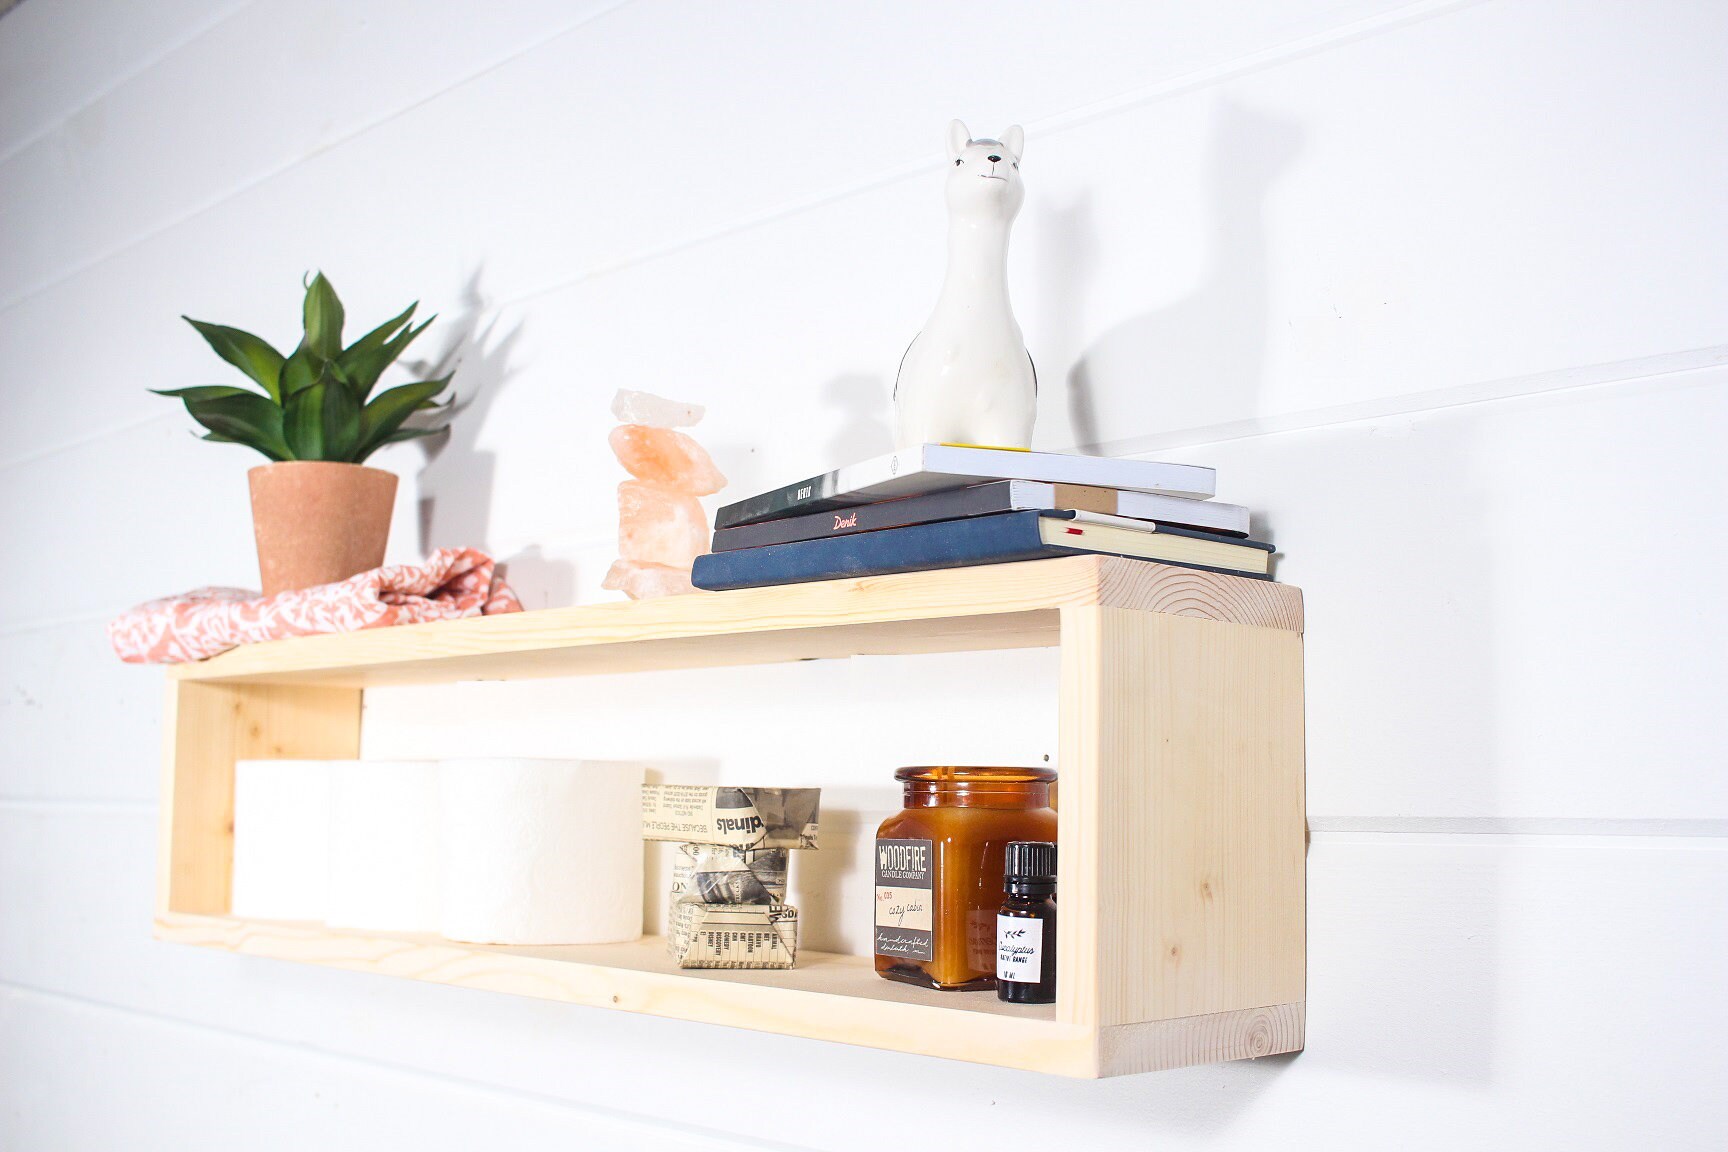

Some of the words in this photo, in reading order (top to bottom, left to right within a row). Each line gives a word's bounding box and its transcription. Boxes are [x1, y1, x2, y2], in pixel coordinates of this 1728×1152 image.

[832, 512, 857, 530] Denik
[717, 816, 763, 834] dinals
[878, 845, 927, 872] WOODFIRE
[882, 870, 902, 879] CANDLE
[903, 871, 924, 880] COMPANY
[889, 905, 905, 926] cozy
[907, 899, 922, 912] cabin
